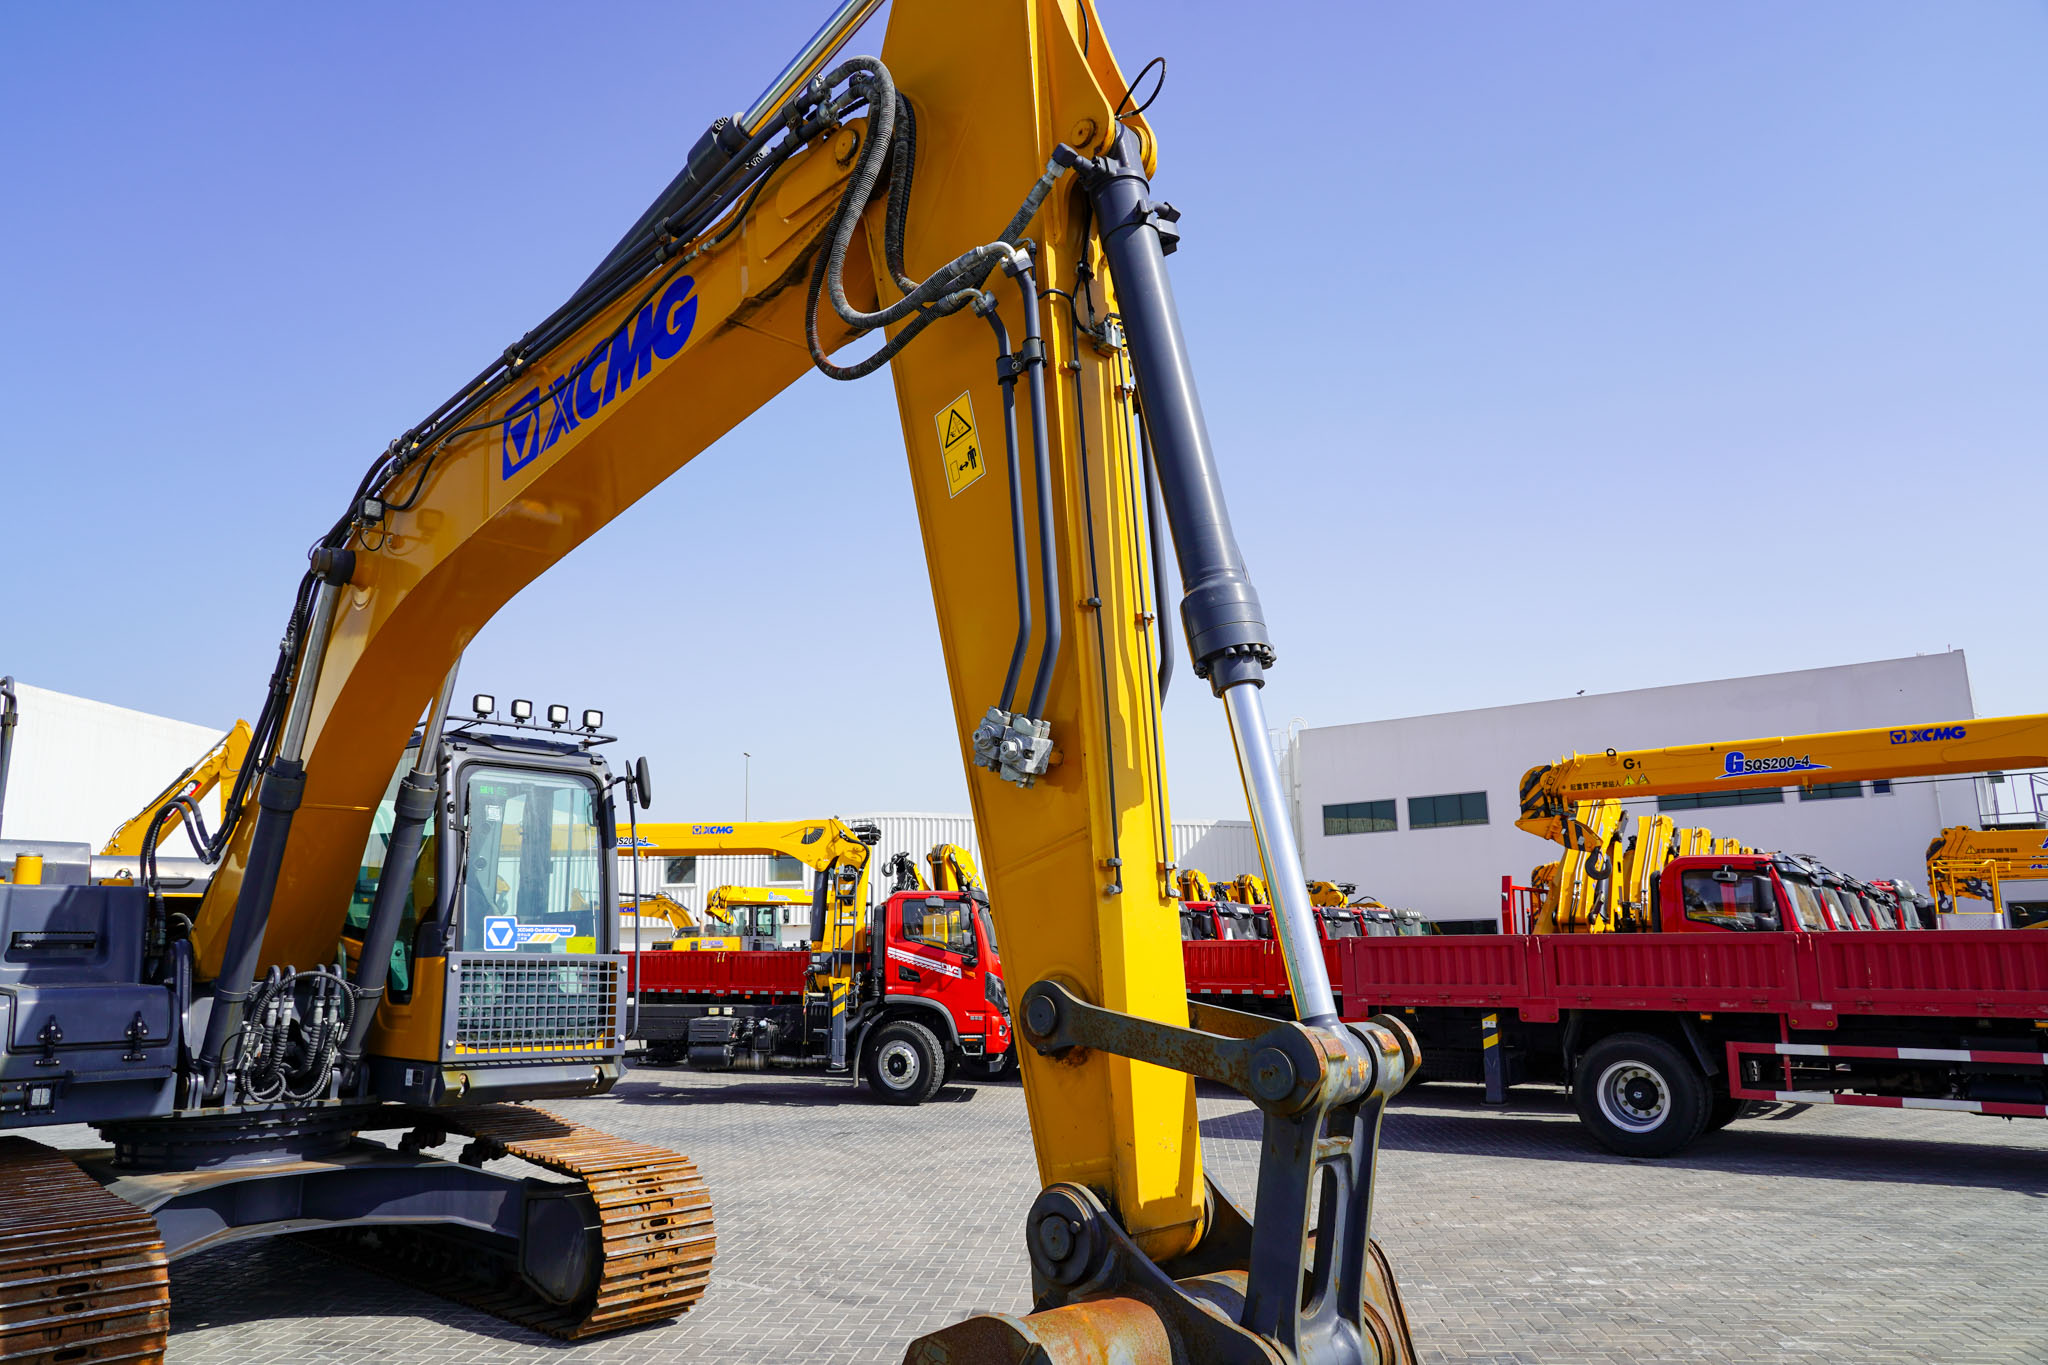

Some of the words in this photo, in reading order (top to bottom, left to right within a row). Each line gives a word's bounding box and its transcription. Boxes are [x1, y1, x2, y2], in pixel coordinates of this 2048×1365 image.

[539, 275, 698, 455] XCMG
[1907, 726, 1967, 743] XCMG
[703, 826, 734, 834] XCMG
